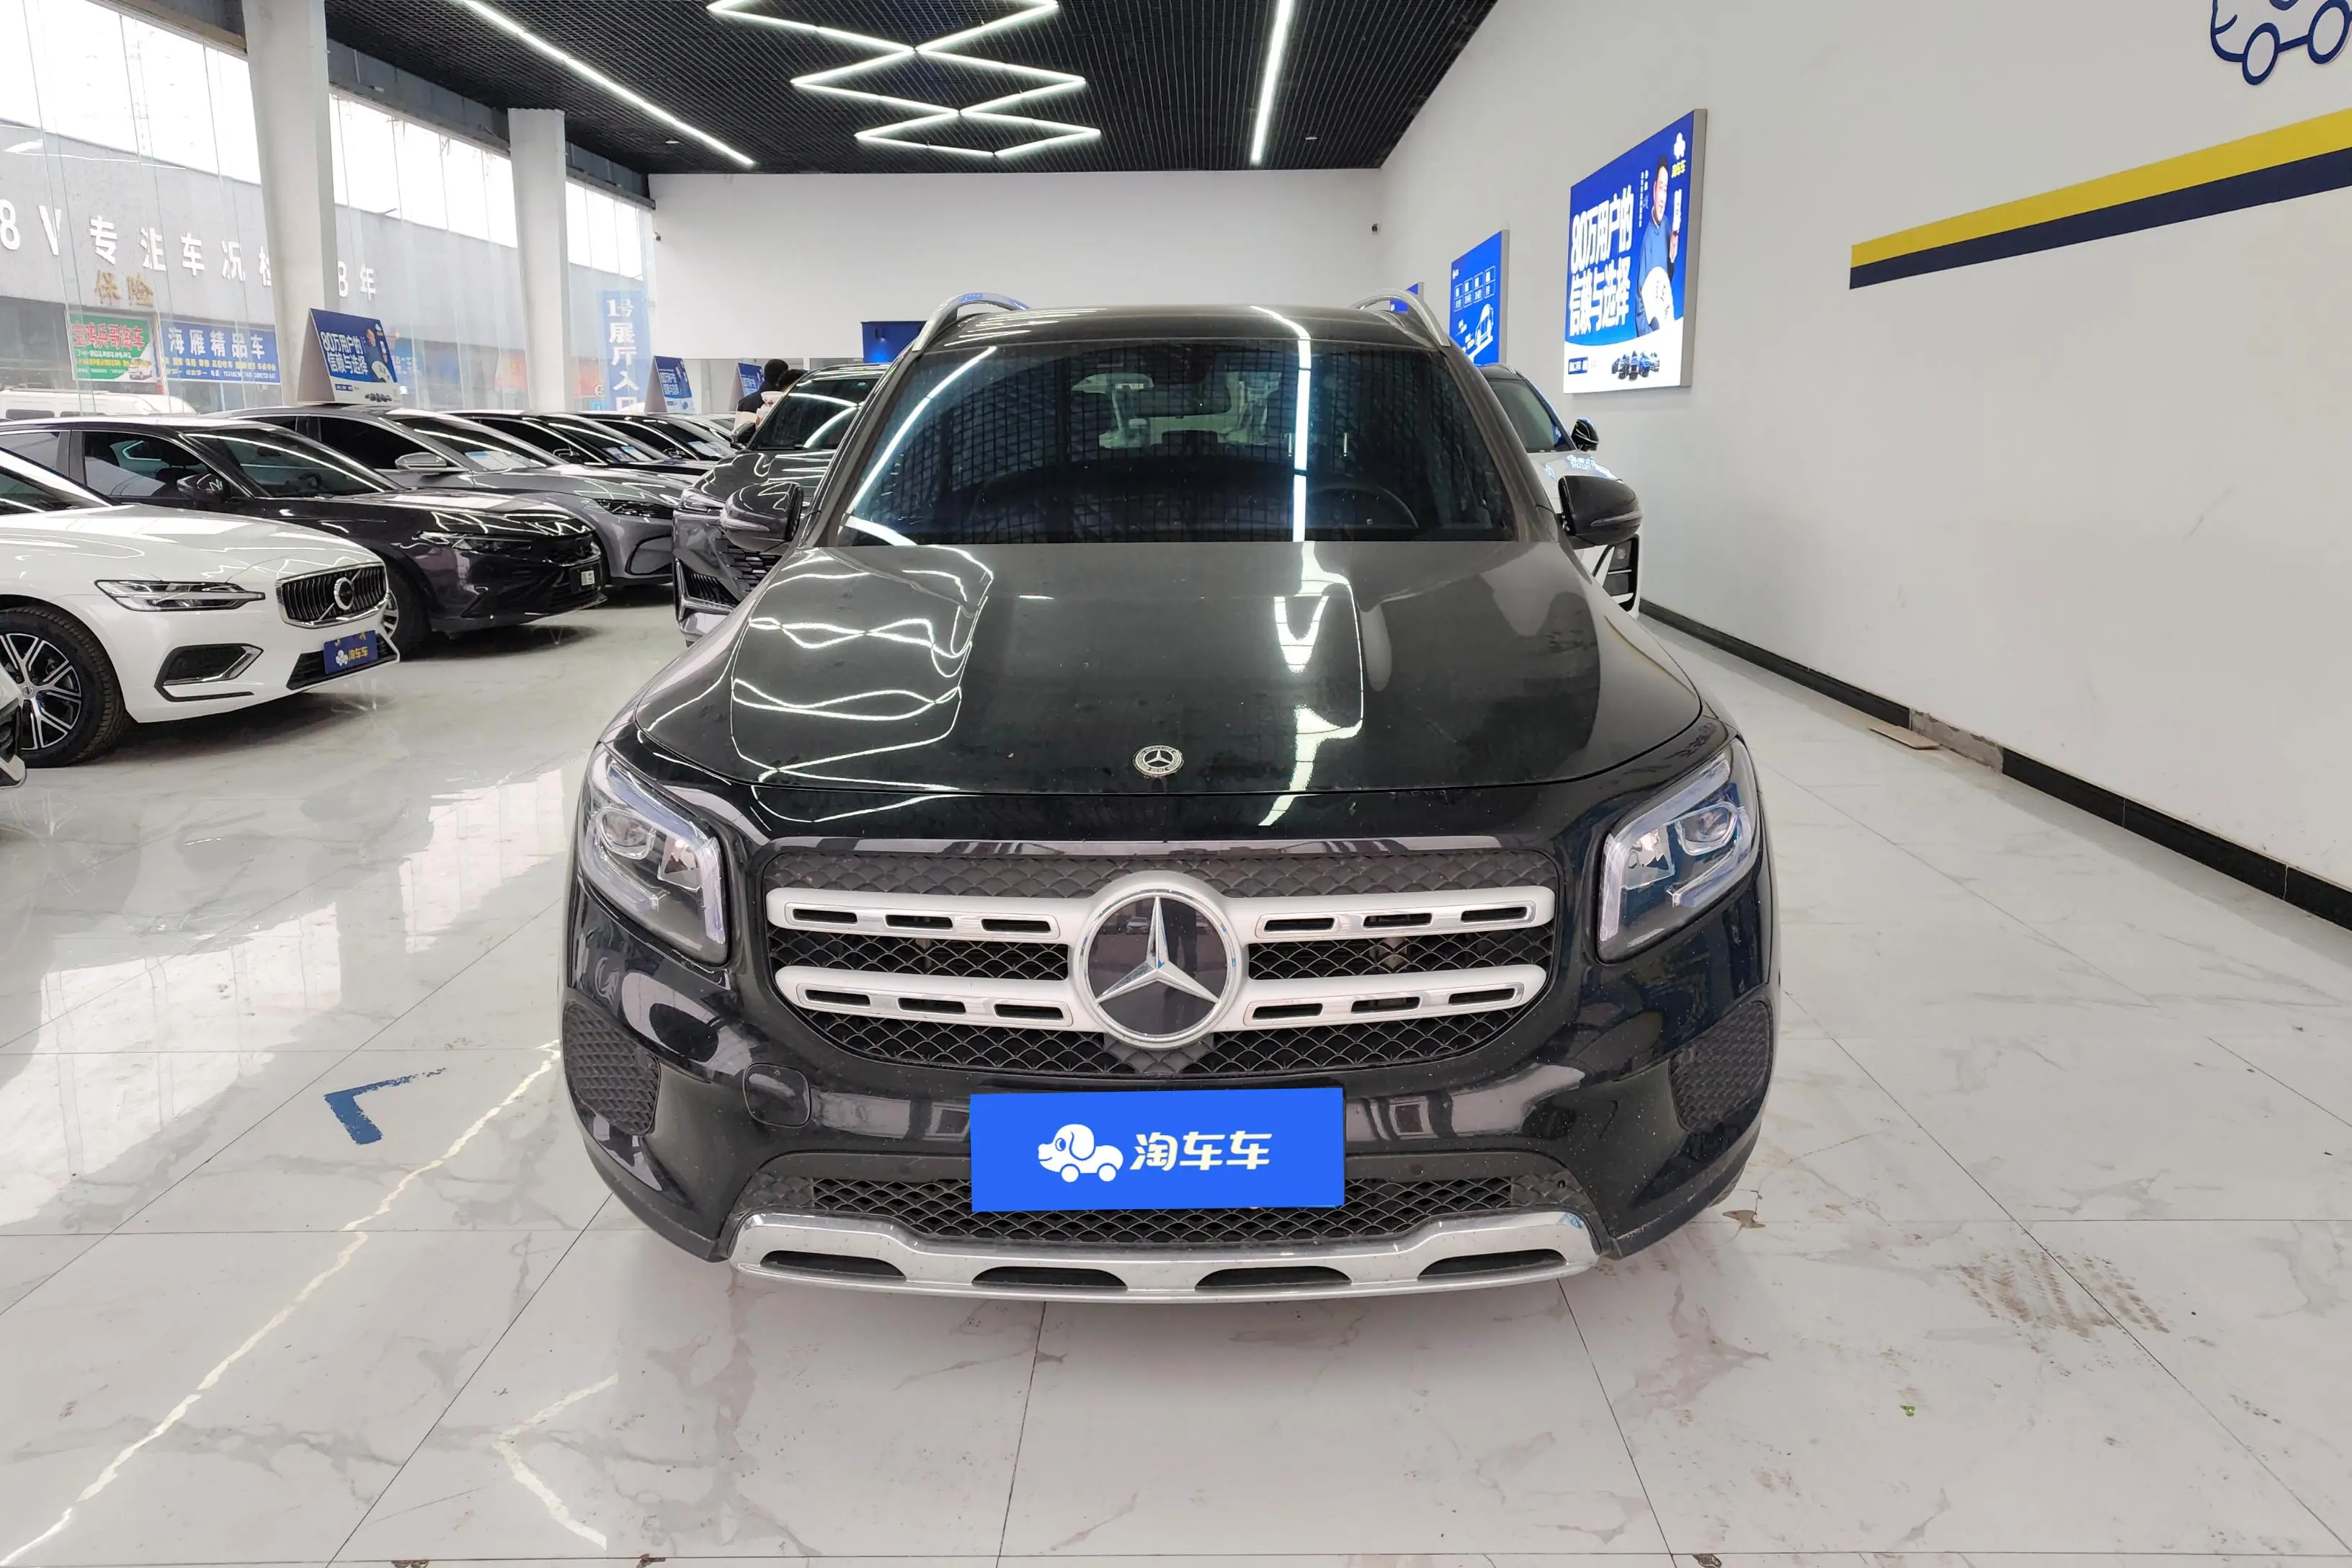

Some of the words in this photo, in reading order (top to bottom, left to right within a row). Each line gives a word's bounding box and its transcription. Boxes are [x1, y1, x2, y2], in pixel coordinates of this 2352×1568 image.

[1571, 184, 1634, 274] 80万用户的
[94, 269, 154, 308] 保险
[1569, 256, 1631, 337] 信赖与选择
[167, 326, 265, 360] 海雁精品车
[320, 331, 364, 355] 80万用户的
[327, 351, 369, 375] 信赖与选择
[1129, 1130, 1273, 1172] 淘车车
